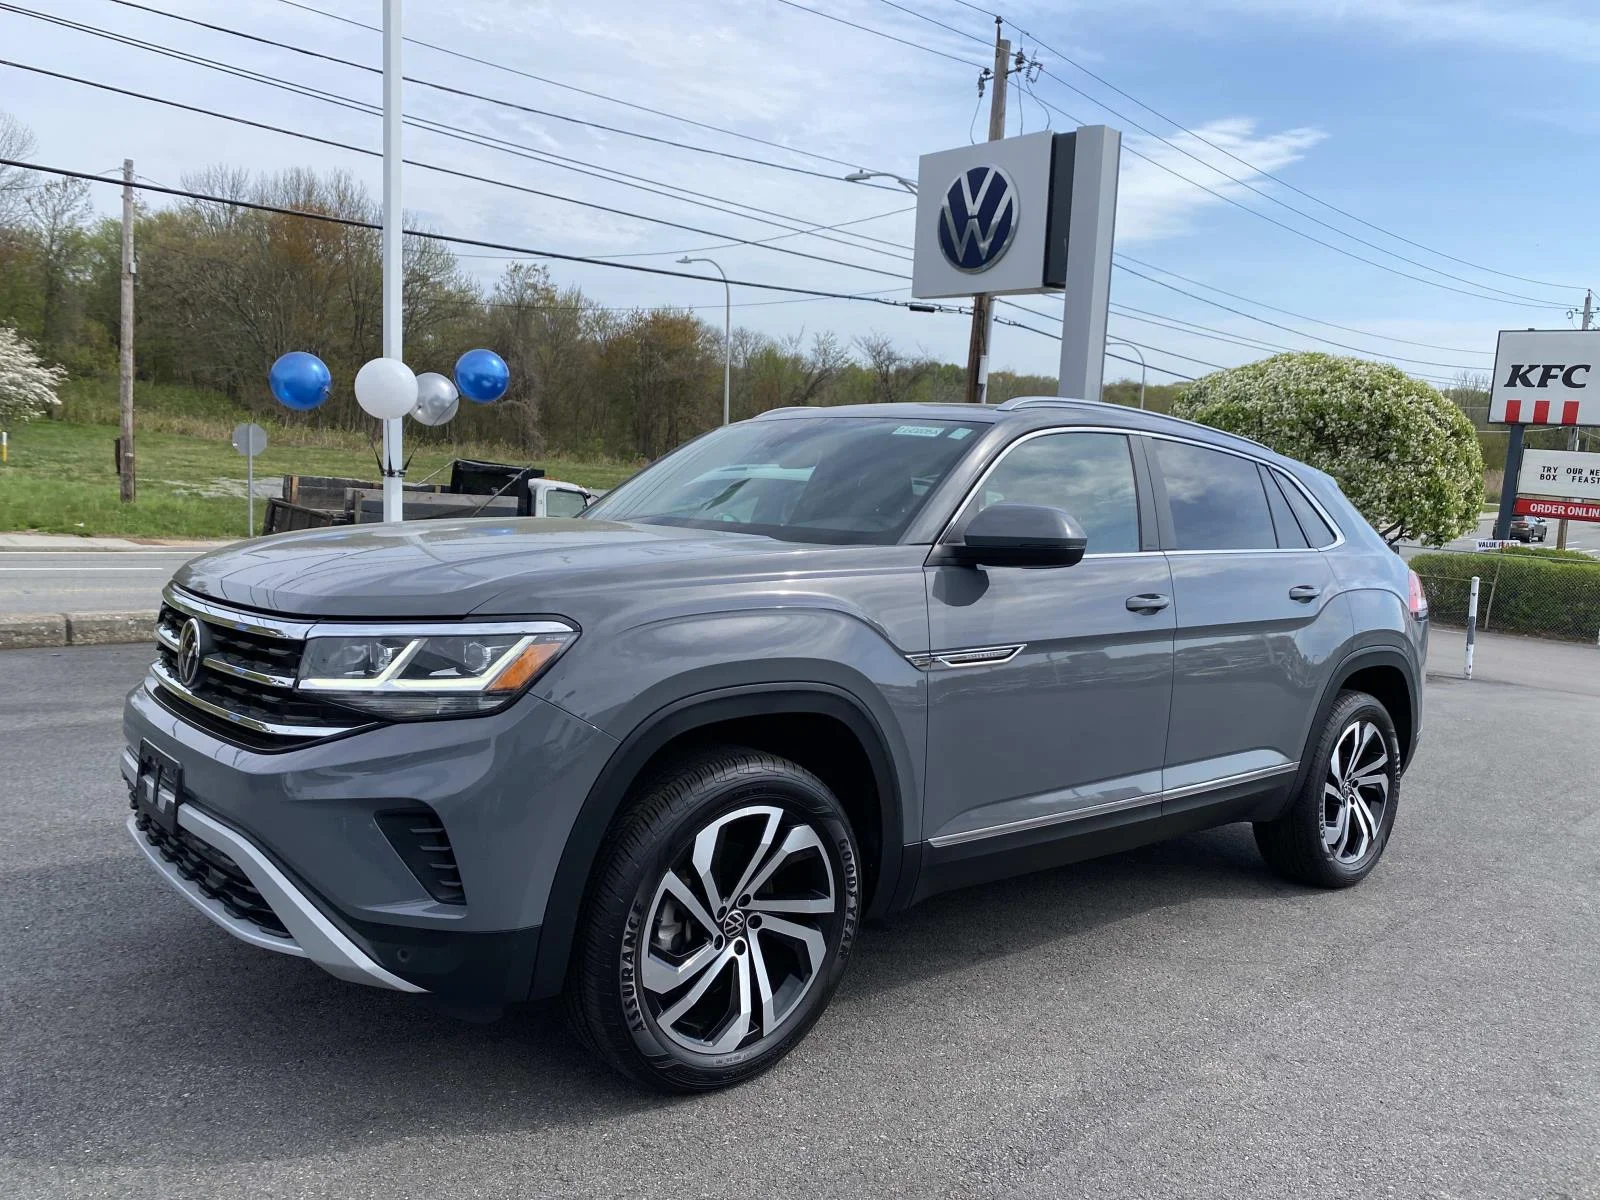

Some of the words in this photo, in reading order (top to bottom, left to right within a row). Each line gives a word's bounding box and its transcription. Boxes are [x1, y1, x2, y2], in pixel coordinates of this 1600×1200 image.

[1503, 364, 1592, 389] KFC
[1566, 467, 1583, 475] OUR
[1530, 503, 1565, 515] ORDER
[1478, 541, 1497, 549] VALUE
